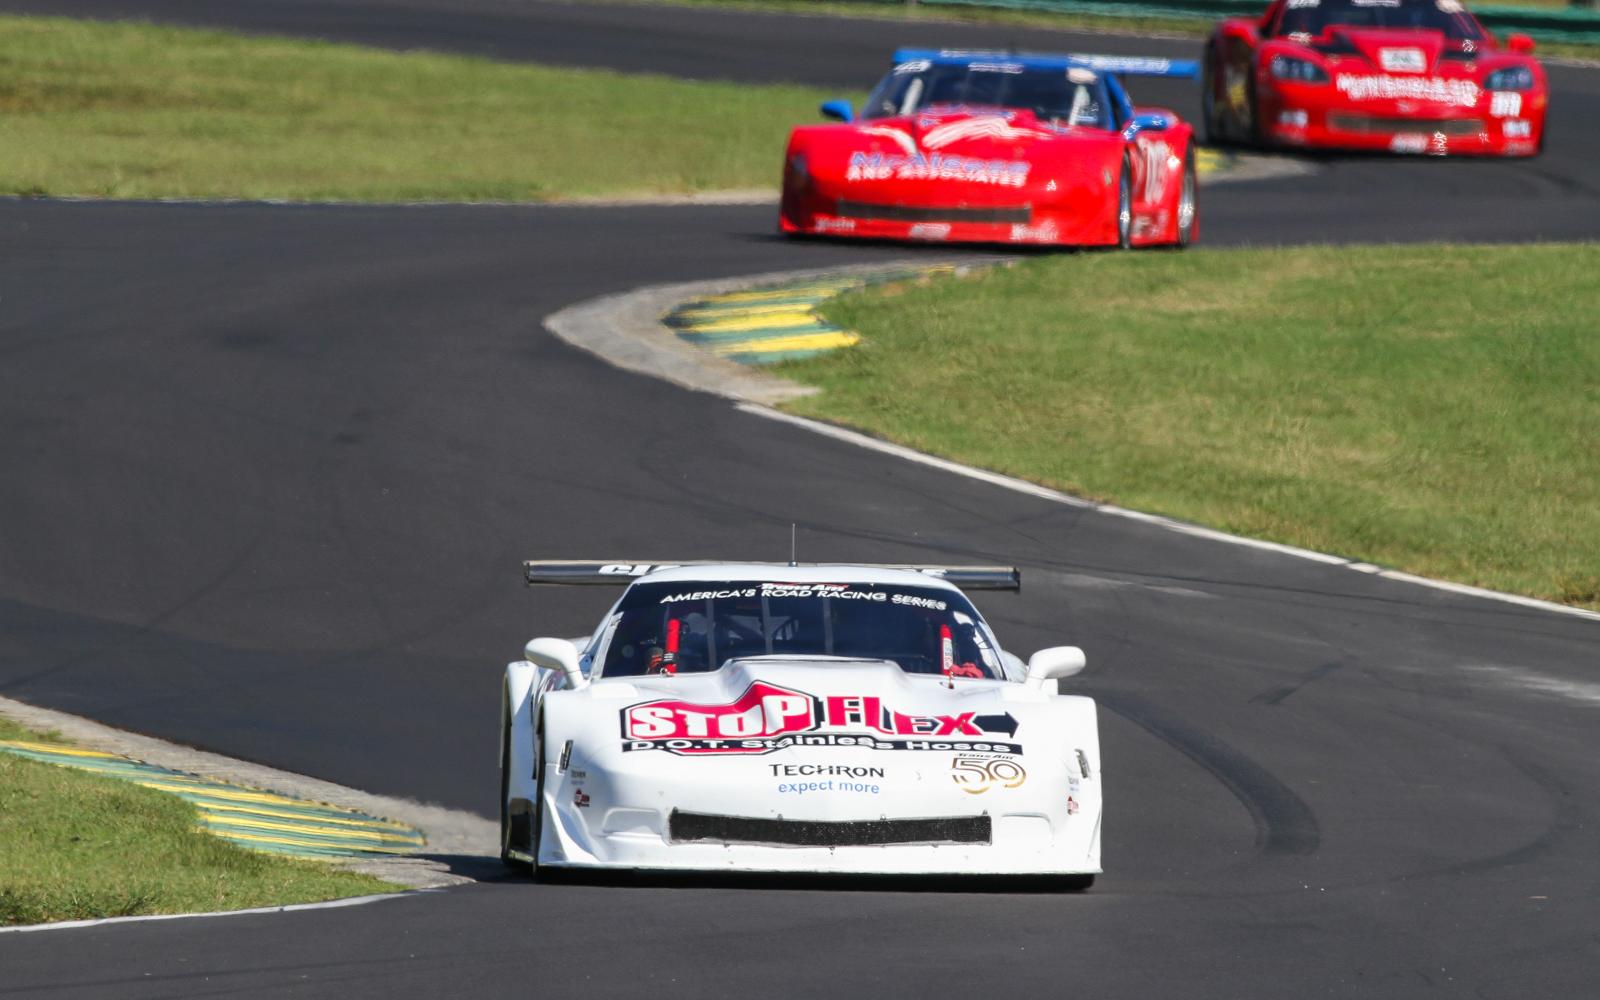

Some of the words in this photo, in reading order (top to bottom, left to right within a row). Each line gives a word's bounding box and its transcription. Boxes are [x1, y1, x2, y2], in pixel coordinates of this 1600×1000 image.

[660, 588, 756, 604] AMERICA'S
[761, 588, 813, 598] ROAD
[817, 590, 887, 602] RACING
[891, 593, 947, 611] SERIES
[631, 695, 809, 738] STOP
[826, 696, 983, 736] FLEX
[631, 740, 729, 751] D.O.T.
[741, 735, 895, 751] Stainless
[906, 740, 1011, 753] Hoses
[768, 764, 885, 778] TECHRON
[952, 757, 1027, 795] 50
[778, 780, 833, 794] expect
[839, 781, 880, 794] more
